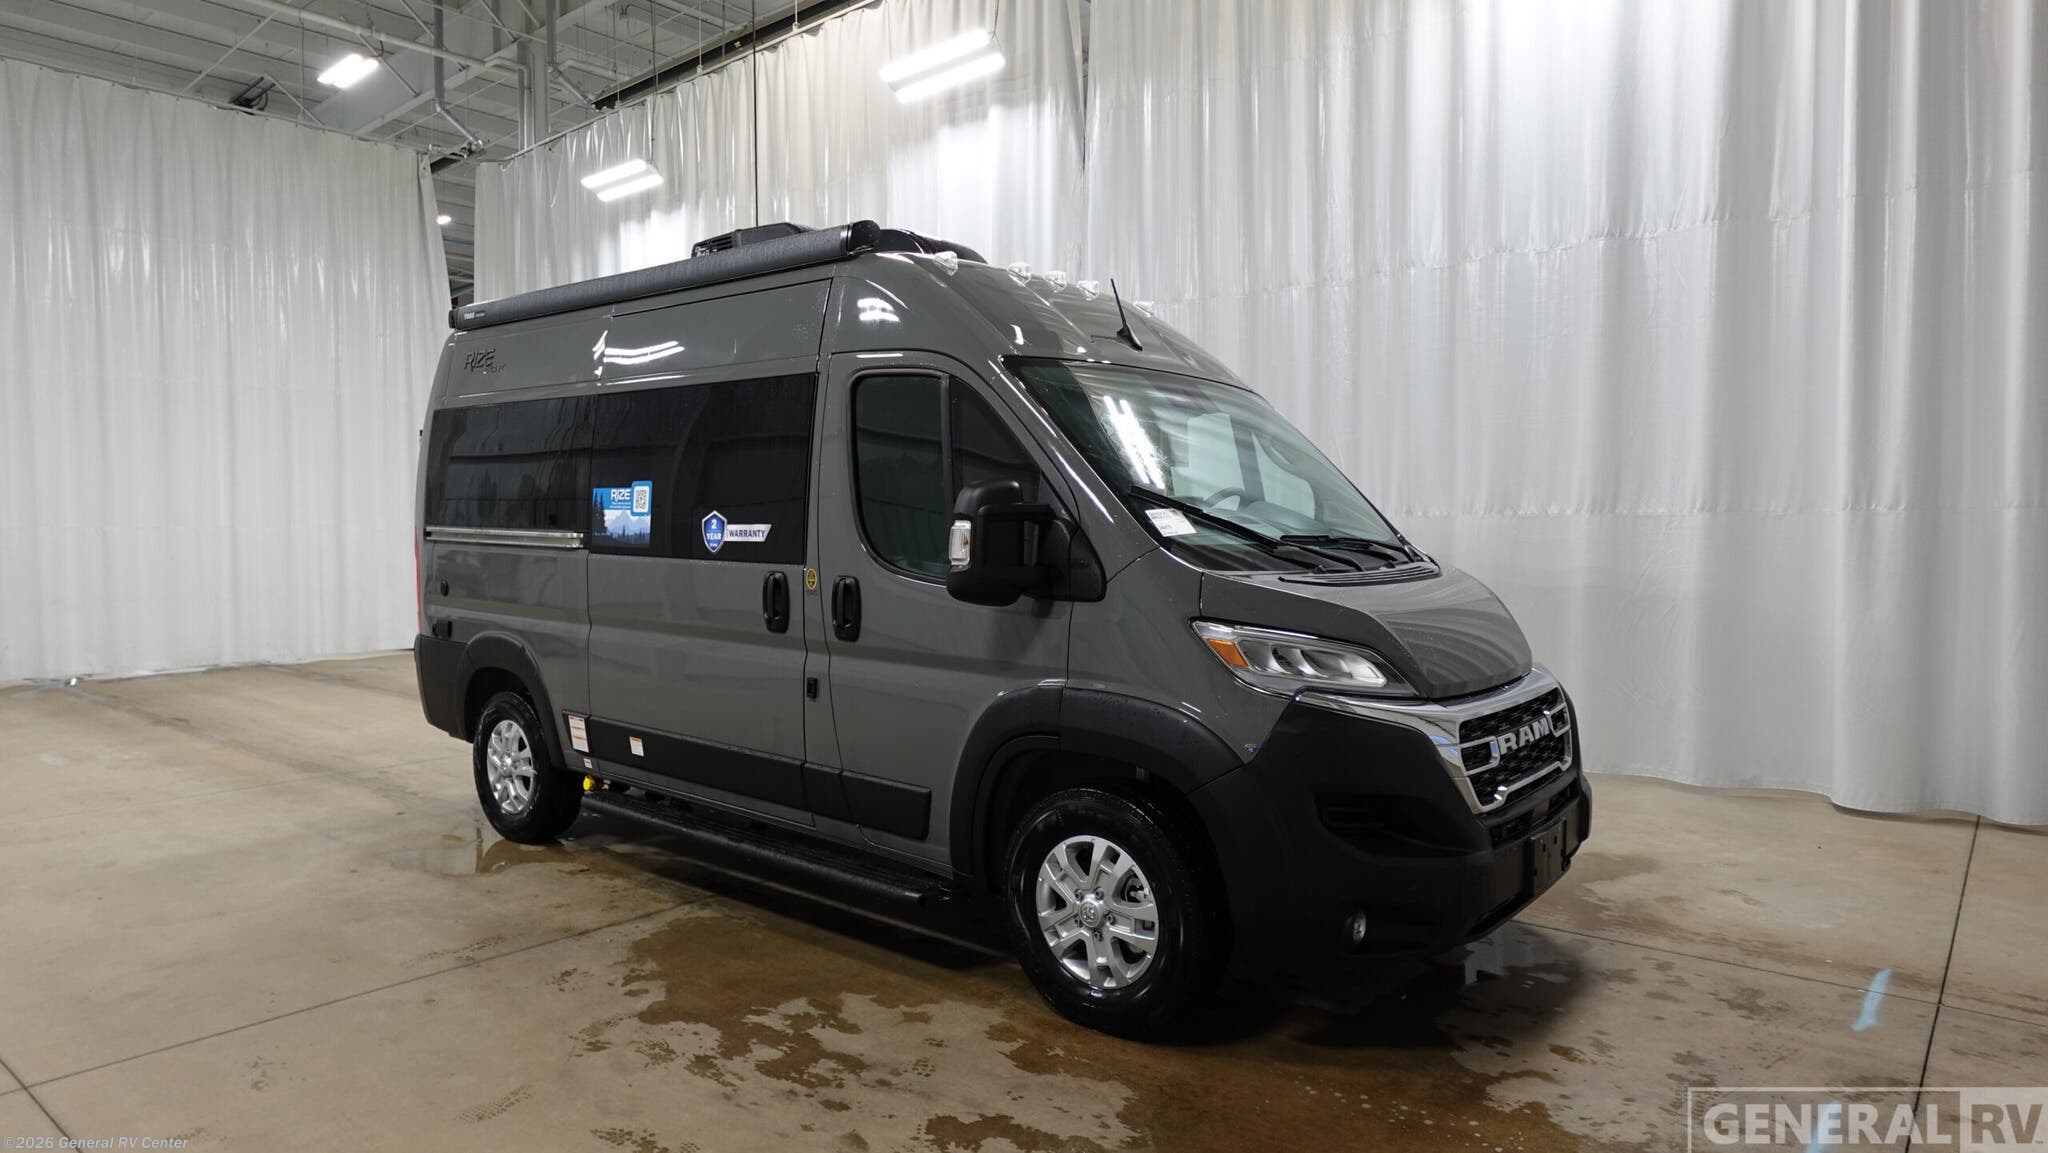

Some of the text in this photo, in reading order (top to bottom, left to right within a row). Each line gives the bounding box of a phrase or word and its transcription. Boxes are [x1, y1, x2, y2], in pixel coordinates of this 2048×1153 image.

[464, 349, 496, 372] RIZE
[610, 488, 631, 502] RIZE
[711, 519, 718, 529] 2
[706, 532, 722, 541] YEAR
[728, 529, 766, 538] WARRANTY
[1497, 717, 1551, 756] RAM
